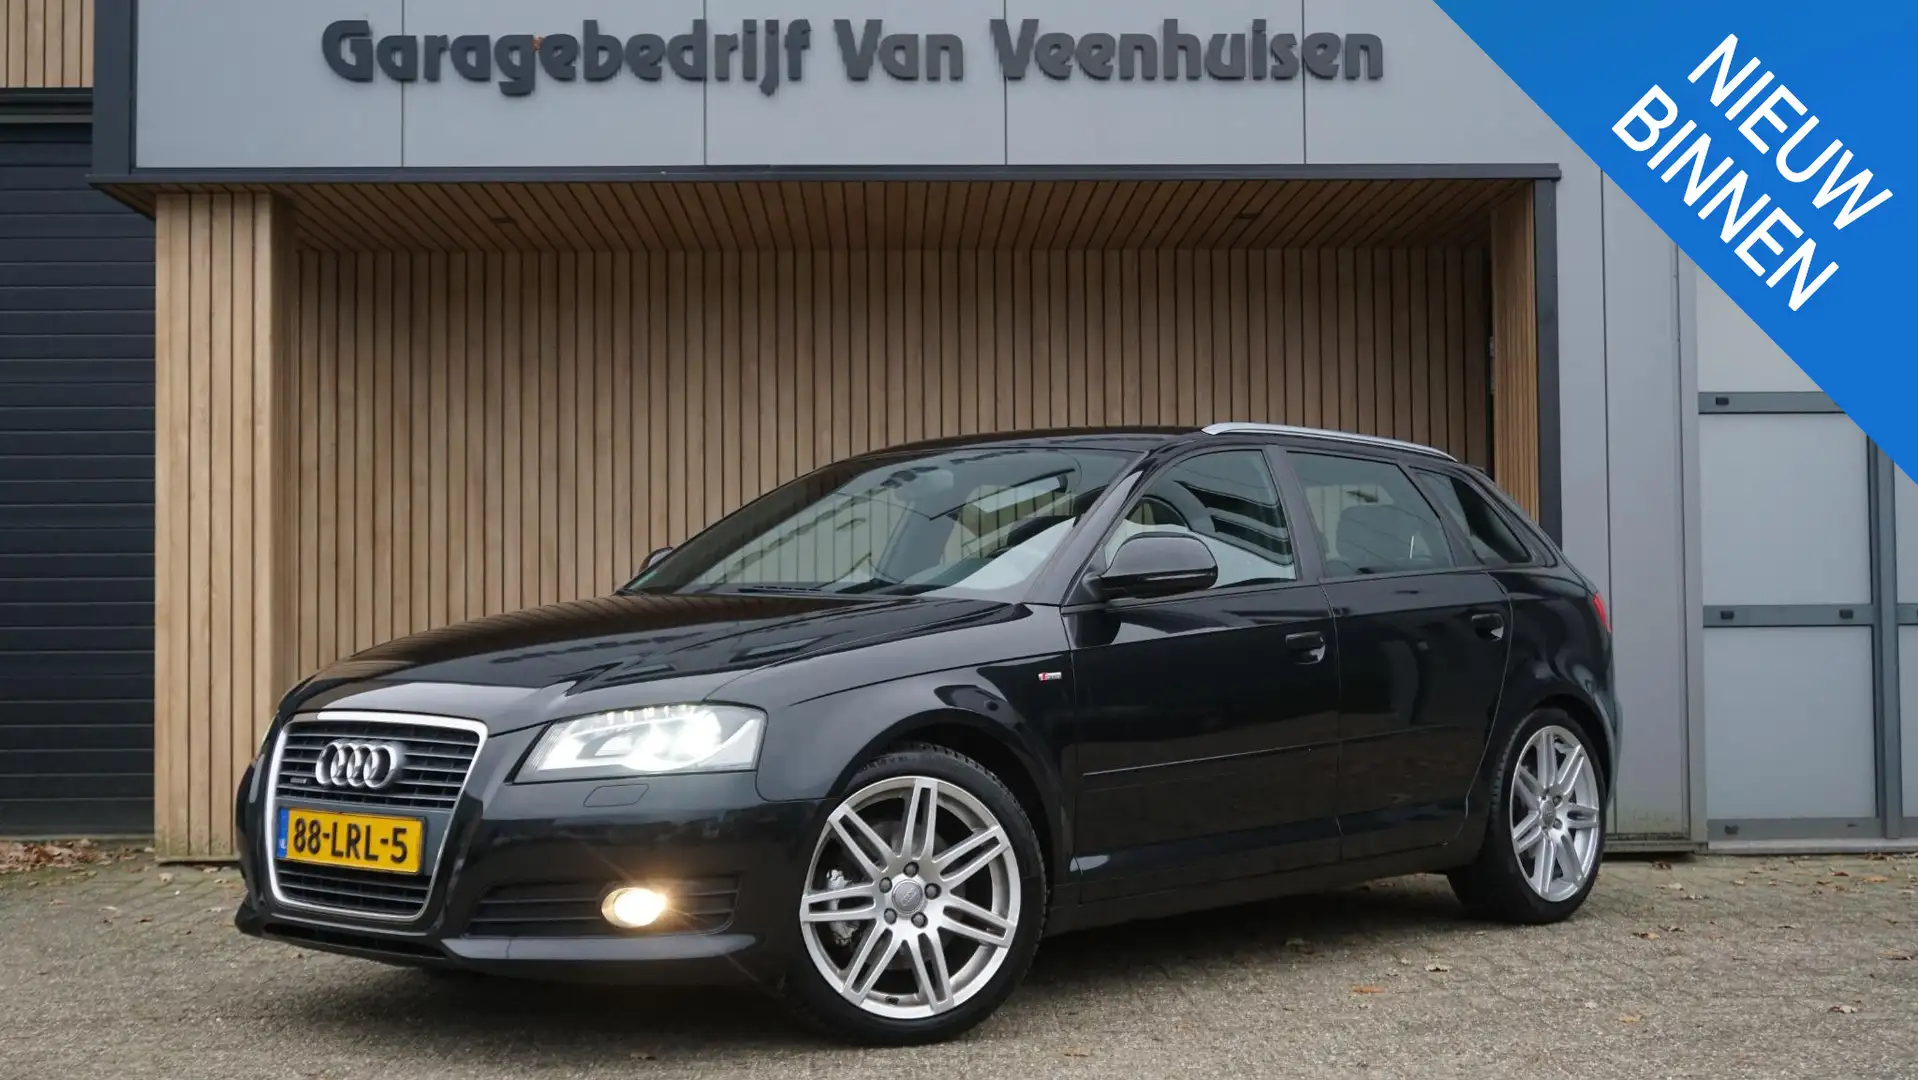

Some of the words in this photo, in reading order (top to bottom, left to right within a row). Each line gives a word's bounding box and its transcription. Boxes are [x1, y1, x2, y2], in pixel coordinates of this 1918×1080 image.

[322, 19, 811, 97] Garagebedrijf
[834, 19, 964, 82] Van
[990, 19, 1383, 82] Veenhuisen
[293, 817, 408, 864] 88-LRL-5
